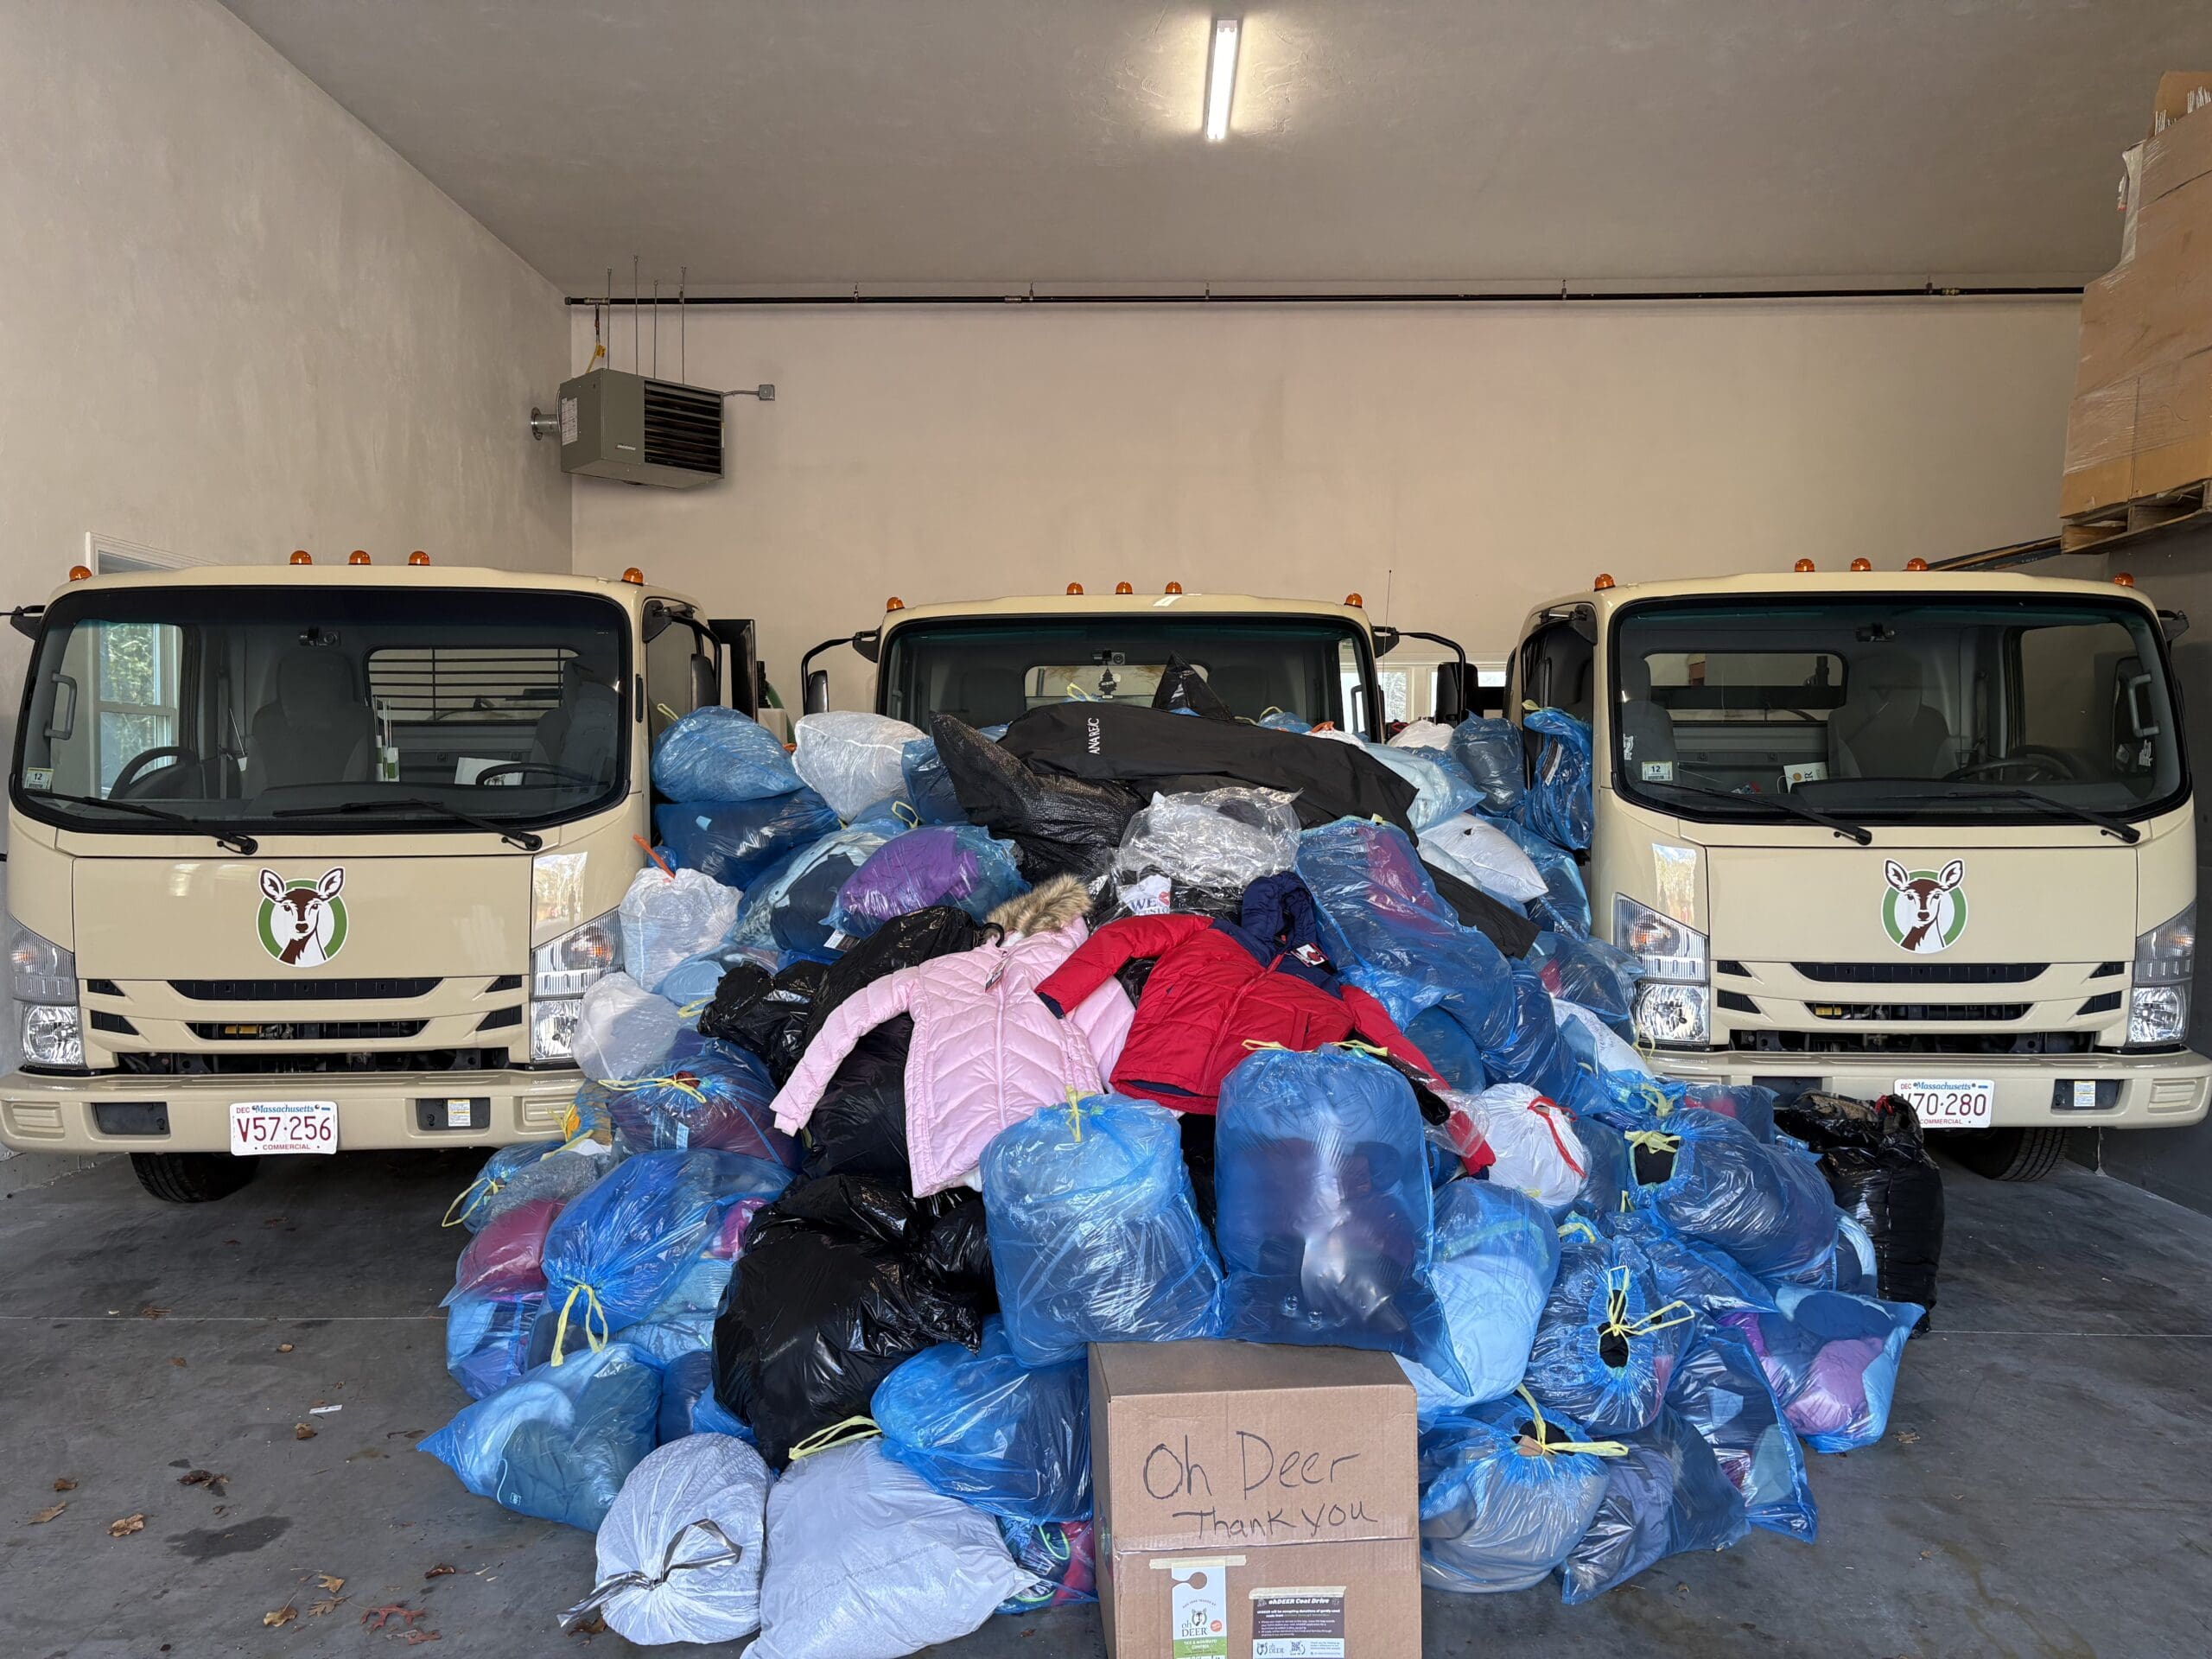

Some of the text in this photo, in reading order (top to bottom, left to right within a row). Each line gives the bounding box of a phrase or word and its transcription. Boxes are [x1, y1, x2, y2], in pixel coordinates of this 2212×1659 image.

[255, 1104, 315, 1113] Massachusetts
[1143, 1431, 1360, 1500] Oh Deer
[1182, 1628, 1208, 1637] DEER
